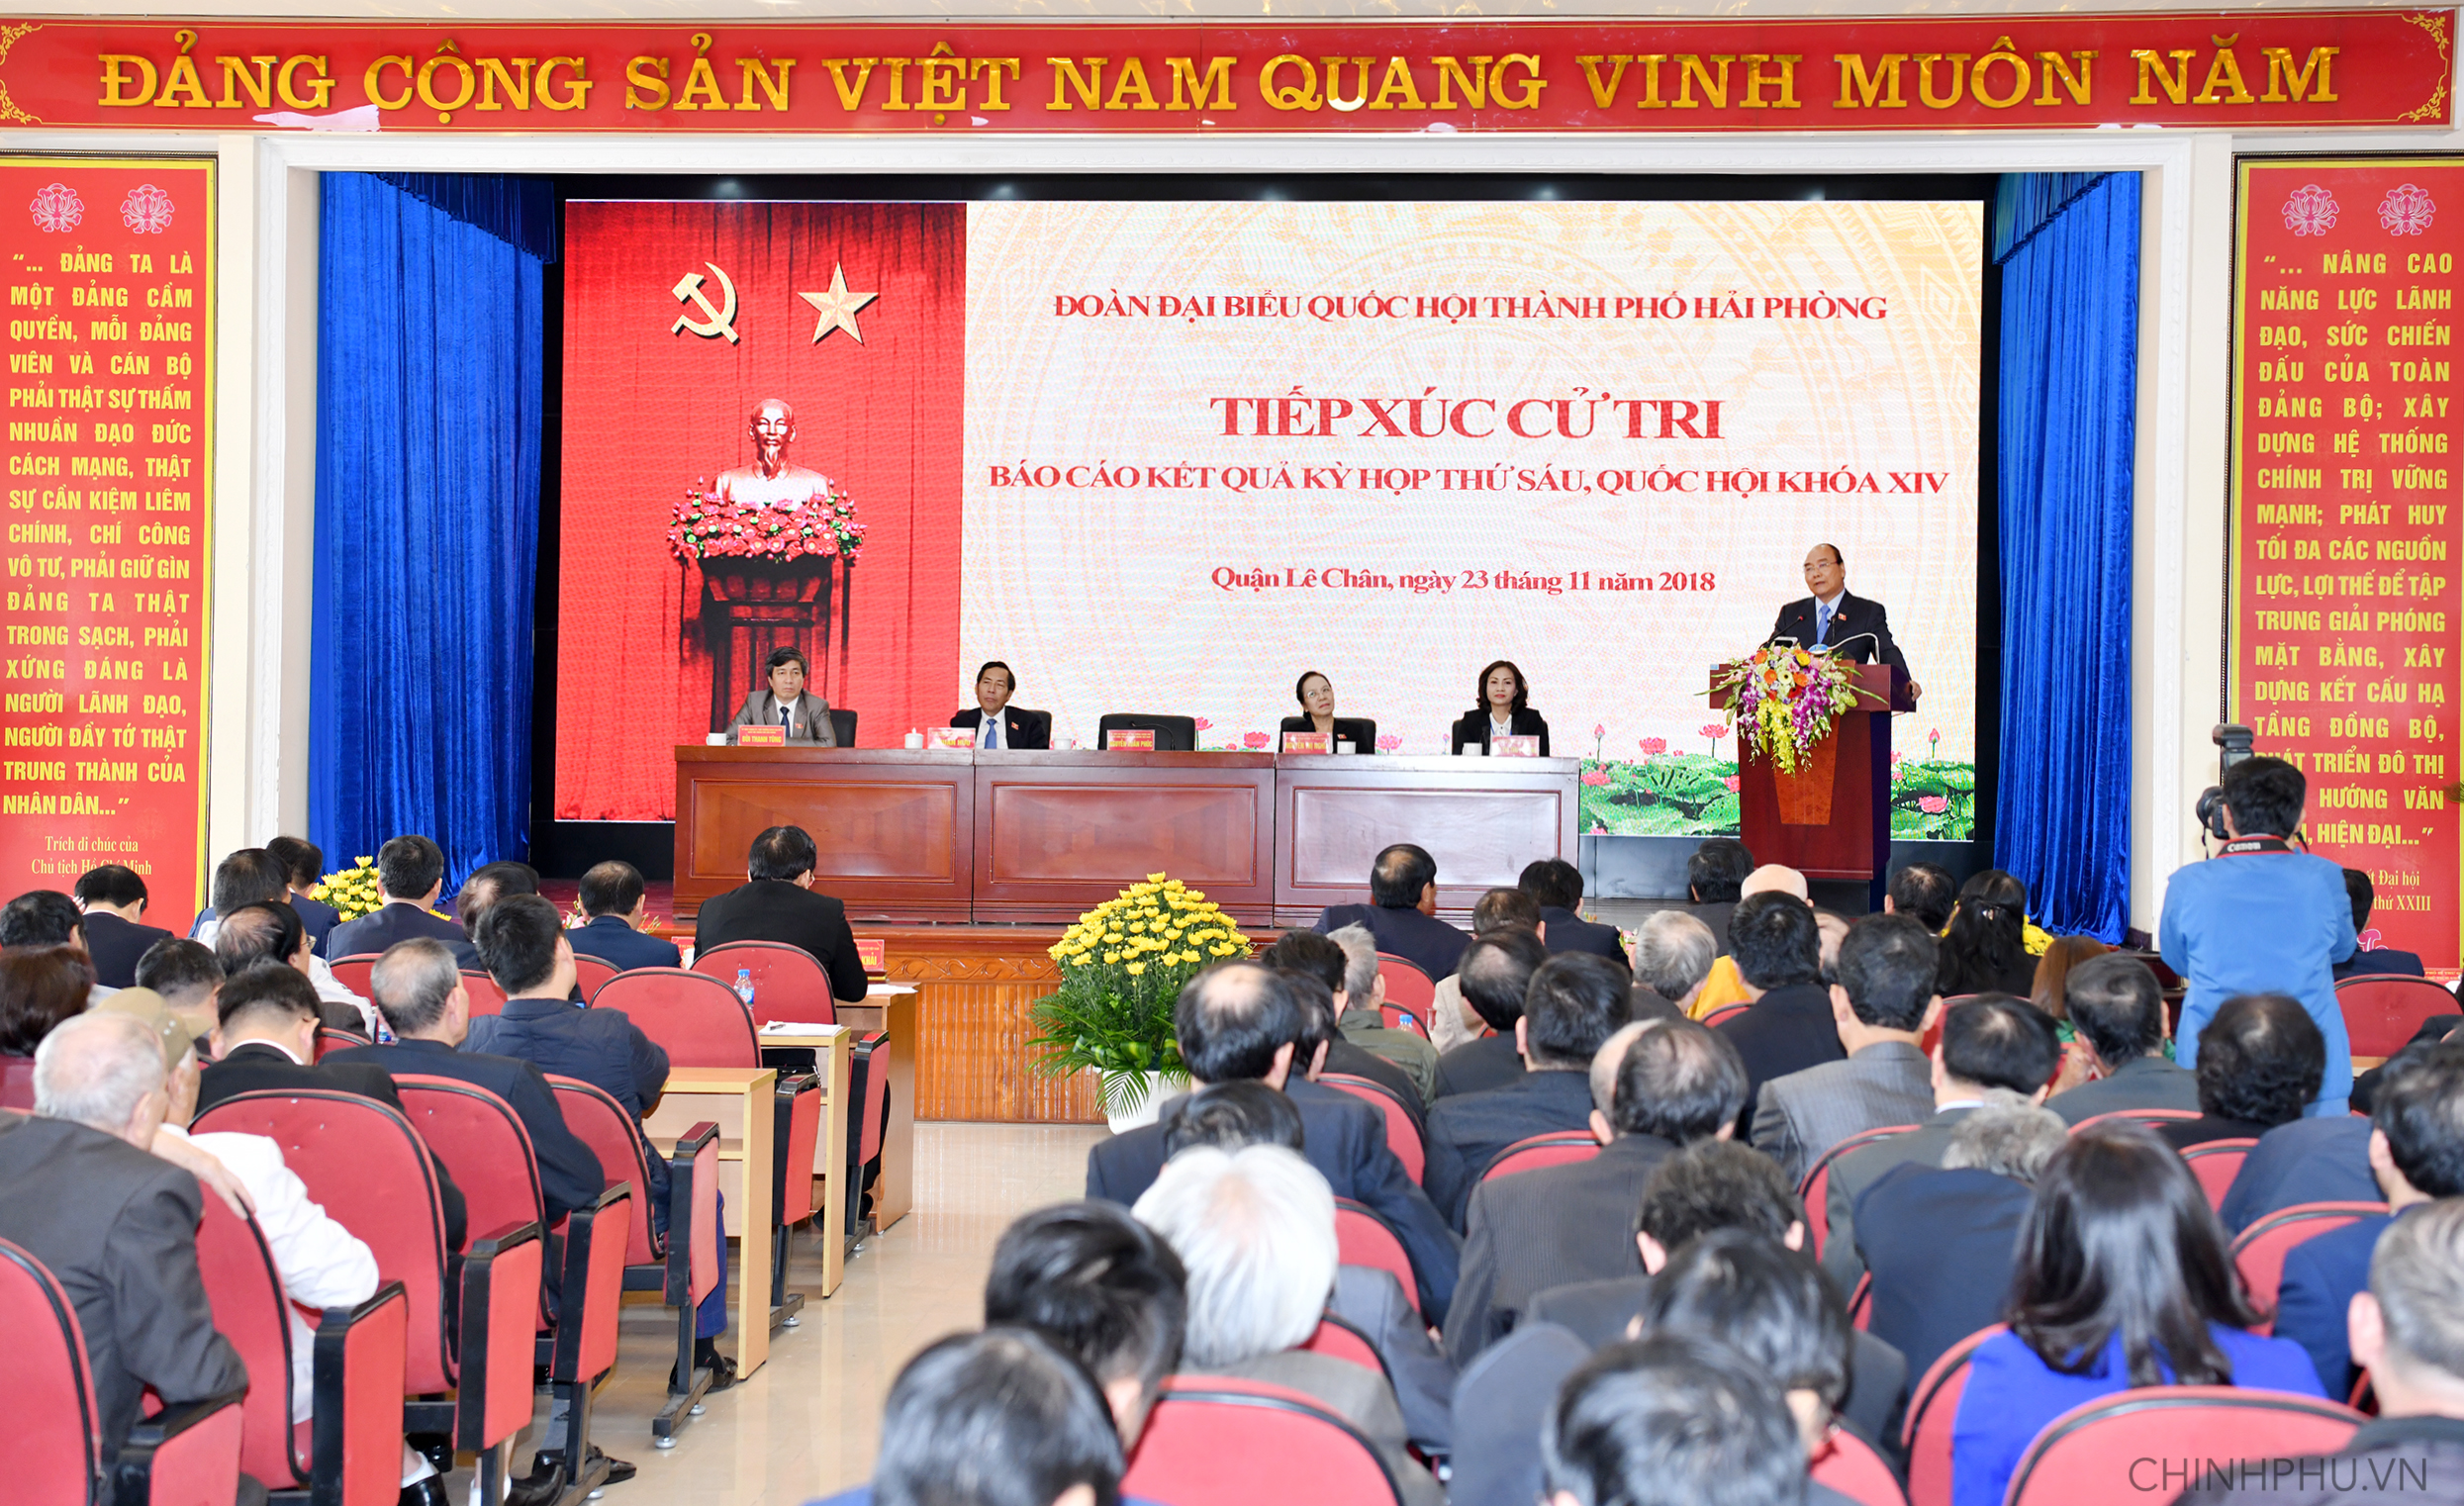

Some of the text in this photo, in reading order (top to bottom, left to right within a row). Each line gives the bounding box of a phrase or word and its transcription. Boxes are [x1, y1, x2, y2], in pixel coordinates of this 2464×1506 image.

[98, 30, 2340, 126] ĐẢNG CỘNG SẢN VIỆT NAM QUANG VINH MUÔN NĂM
[59, 244, 113, 273] ĐẢNG
[129, 253, 153, 274] TA
[169, 250, 194, 274] LÀ
[2322, 248, 2387, 274] NÂNG
[2407, 252, 2453, 274] CAO
[10, 278, 193, 311] MỘT ĐẢNG CẦM
[1054, 288, 1887, 325] ĐOÀN ĐẠI BIỂU QUỐC HỘI THÀNH PHỐ HẢI PHÒNG
[2260, 285, 2452, 315] NĂNG LỰC LÃNH
[2259, 318, 2451, 351] ĐẠO, SỨC CHIẾN
[9, 349, 192, 381] VIÊN VÀ CÁN BỘ
[2258, 352, 2450, 383] ĐẤU CỦA TOÀN
[9, 379, 192, 414] PHẢI THẬT SỰ THẤM
[1209, 385, 1726, 439] TIẾP XÚC CỬ TRI
[9, 416, 192, 447] NHUẦN ĐẠO ĐỨC
[988, 458, 1950, 500] BÁO CÁO KẾT QUẢ KỲ HỌP THỨ SÁU, QUỐC HỘI KHÓA XIV
[2257, 463, 2448, 494] CHÍNH TRỊ VỮNG
[8, 483, 191, 516] SỰ CẦN KIỆM LIÊM
[8, 519, 191, 546] CHÍNH, CHÍ CÔNG
[2255, 532, 2447, 561] TỐI ĐA CÁC NGUỒN
[7, 549, 190, 581] VÔ TƯ, PHẢI GIỮ GÌN
[1211, 566, 1716, 596] Quận Lê Chân, ngày 23 tháng 11 năm 2018
[2255, 567, 2446, 602] LỰC, LỢI THẾ ĐỂ TẬP
[2255, 602, 2446, 633] TRUNG GIẢI PHÓNG
[6, 618, 189, 651] TRONG SẠCH, PHẢI
[5, 653, 188, 682] XỨNG ĐÁNG LÀ
[2254, 674, 2445, 708] DỰNG KẾT CẤU HẠ
[4, 720, 188, 753] NGƯỜI ĐẦY TỚ THẬT
[2312, 744, 2371, 774] TRIỂN
[2377, 749, 2406, 775] ĐÔ
[2413, 754, 2444, 780] THỊ
[2, 791, 56, 815] NHÂN
[2319, 782, 2444, 810] HƯỚNG VĂN
[44, 835, 139, 853] Trích di chúc của
[2227, 842, 2261, 853] Canon
[2317, 818, 2364, 849] HIỆN
[31, 858, 54, 875] Chủ
[56, 859, 78, 878] tịch
[123, 859, 152, 876] Minh
[2378, 869, 2399, 888] Đại
[2402, 871, 2420, 887] hội
[2373, 894, 2431, 911] thứ XXIII
